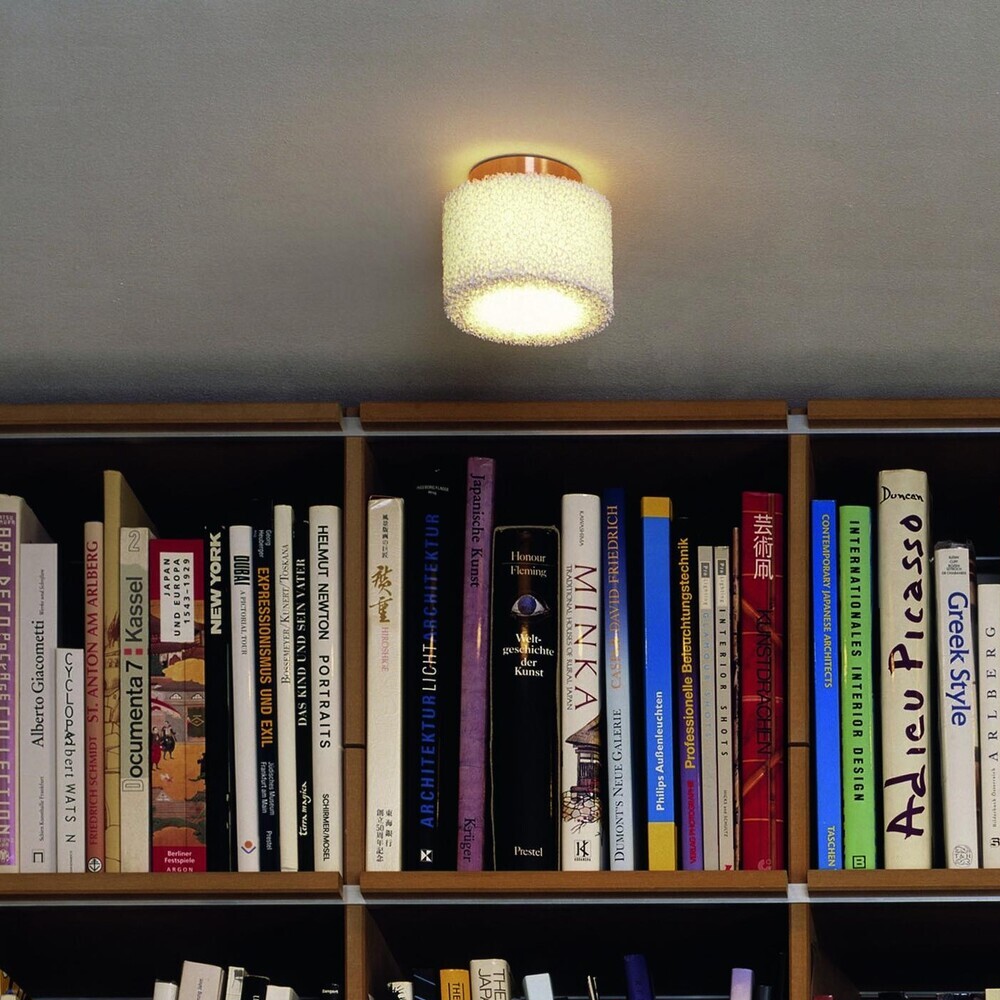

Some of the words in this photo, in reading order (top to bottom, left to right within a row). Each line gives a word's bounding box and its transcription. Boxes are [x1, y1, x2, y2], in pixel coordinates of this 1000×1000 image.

[210, 532, 222, 584] YORK
[318, 526, 328, 578] HELMUT
[511, 551, 546, 562] Honour
[511, 566, 547, 578] Fleming
[125, 577, 143, 642] Kassel
[210, 594, 222, 635] NEW
[318, 582, 329, 640] NEWTON
[678, 538, 692, 672] Beleuchtungstechnik
[849, 520, 862, 657] INTERNATIONALES
[888, 514, 924, 674] Picasso
[258, 568, 272, 683] EXPRESSIONISMUS
[502, 645, 554, 658] geschichte
[516, 633, 542, 645] Welt-
[575, 565, 598, 711] MINKA
[948, 592, 969, 664] Greek
[31, 620, 44, 692] Giacometti
[126, 660, 142, 672] 7
[422, 644, 438, 692] LICHT
[514, 668, 544, 678] Kunst
[521, 658, 537, 668] der
[31, 696, 44, 747] Alberto
[260, 686, 272, 715] UND
[319, 655, 330, 749] PORTRAITS
[682, 676, 696, 769] Professionelle
[852, 666, 862, 738] INTERIOR
[945, 669, 971, 726] Style
[123, 676, 145, 792] Documenta
[261, 720, 273, 747] EXIL
[654, 690, 664, 773] Außenleuchten
[854, 748, 864, 802] DESIGN
[884, 690, 926, 839] Adieu
[656, 775, 666, 810] Philips
[322, 793, 330, 862] SCHIRMER/MOSEL
[514, 846, 543, 857] Prestel
[828, 826, 836, 866] TASCHEN
[452, 982, 460, 1000] THE
